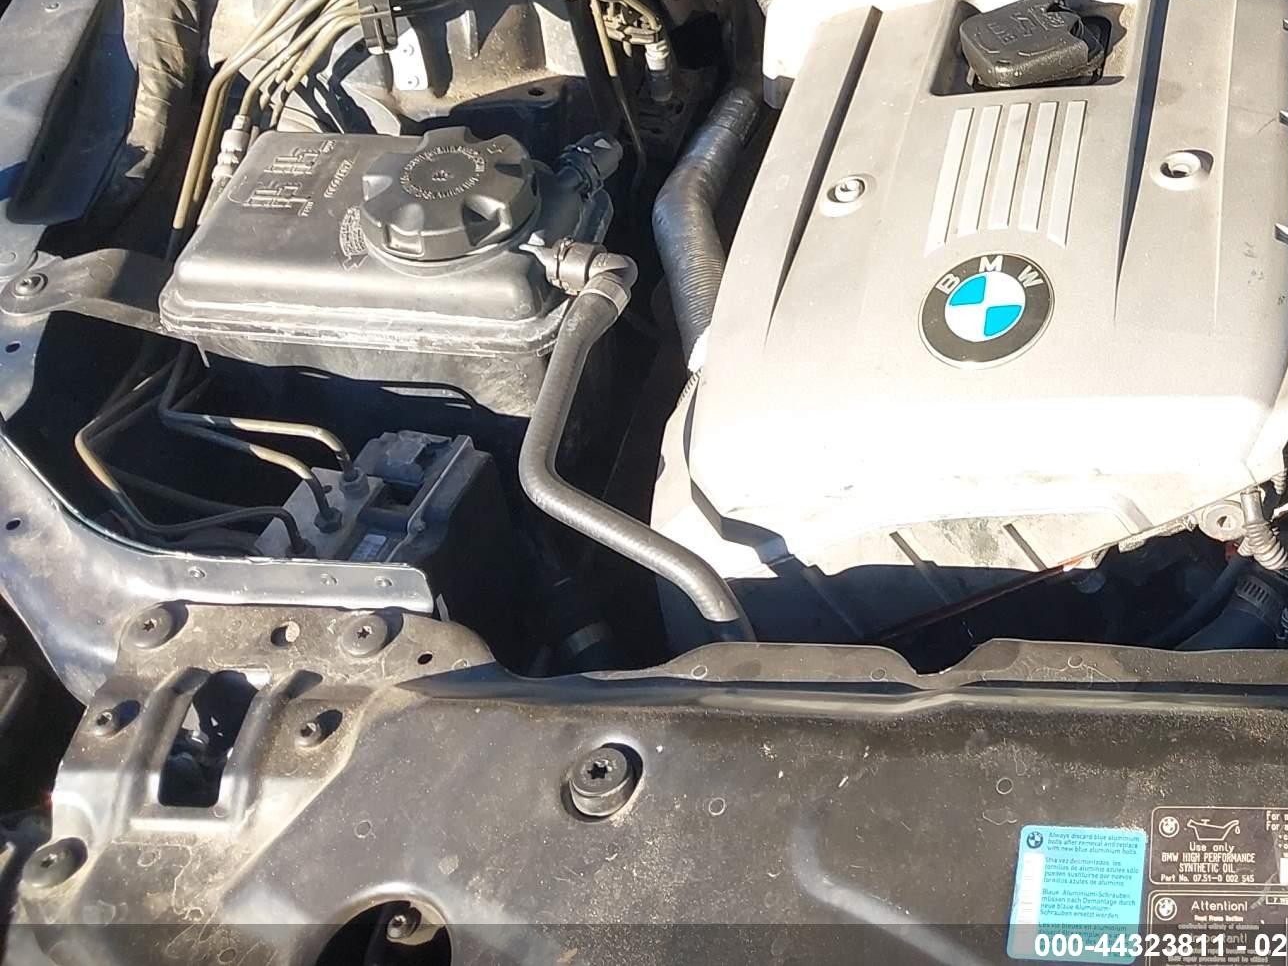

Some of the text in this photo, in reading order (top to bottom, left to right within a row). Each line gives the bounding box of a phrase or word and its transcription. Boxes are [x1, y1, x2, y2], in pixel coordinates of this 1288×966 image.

[935, 255, 1044, 294] BMW
[1266, 811, 1280, 821] For
[1266, 821, 1280, 831] For
[1189, 841, 1235, 854] Use only
[1161, 852, 1256, 863] BMW HIGH PERFORMANCE
[1178, 862, 1235, 873] SYNTHETIC OIL
[1160, 874, 1176, 882] Part
[1178, 874, 1190, 882] No.
[1225, 874, 1239, 882] 002
[1192, 900, 1248, 912] Attention!
